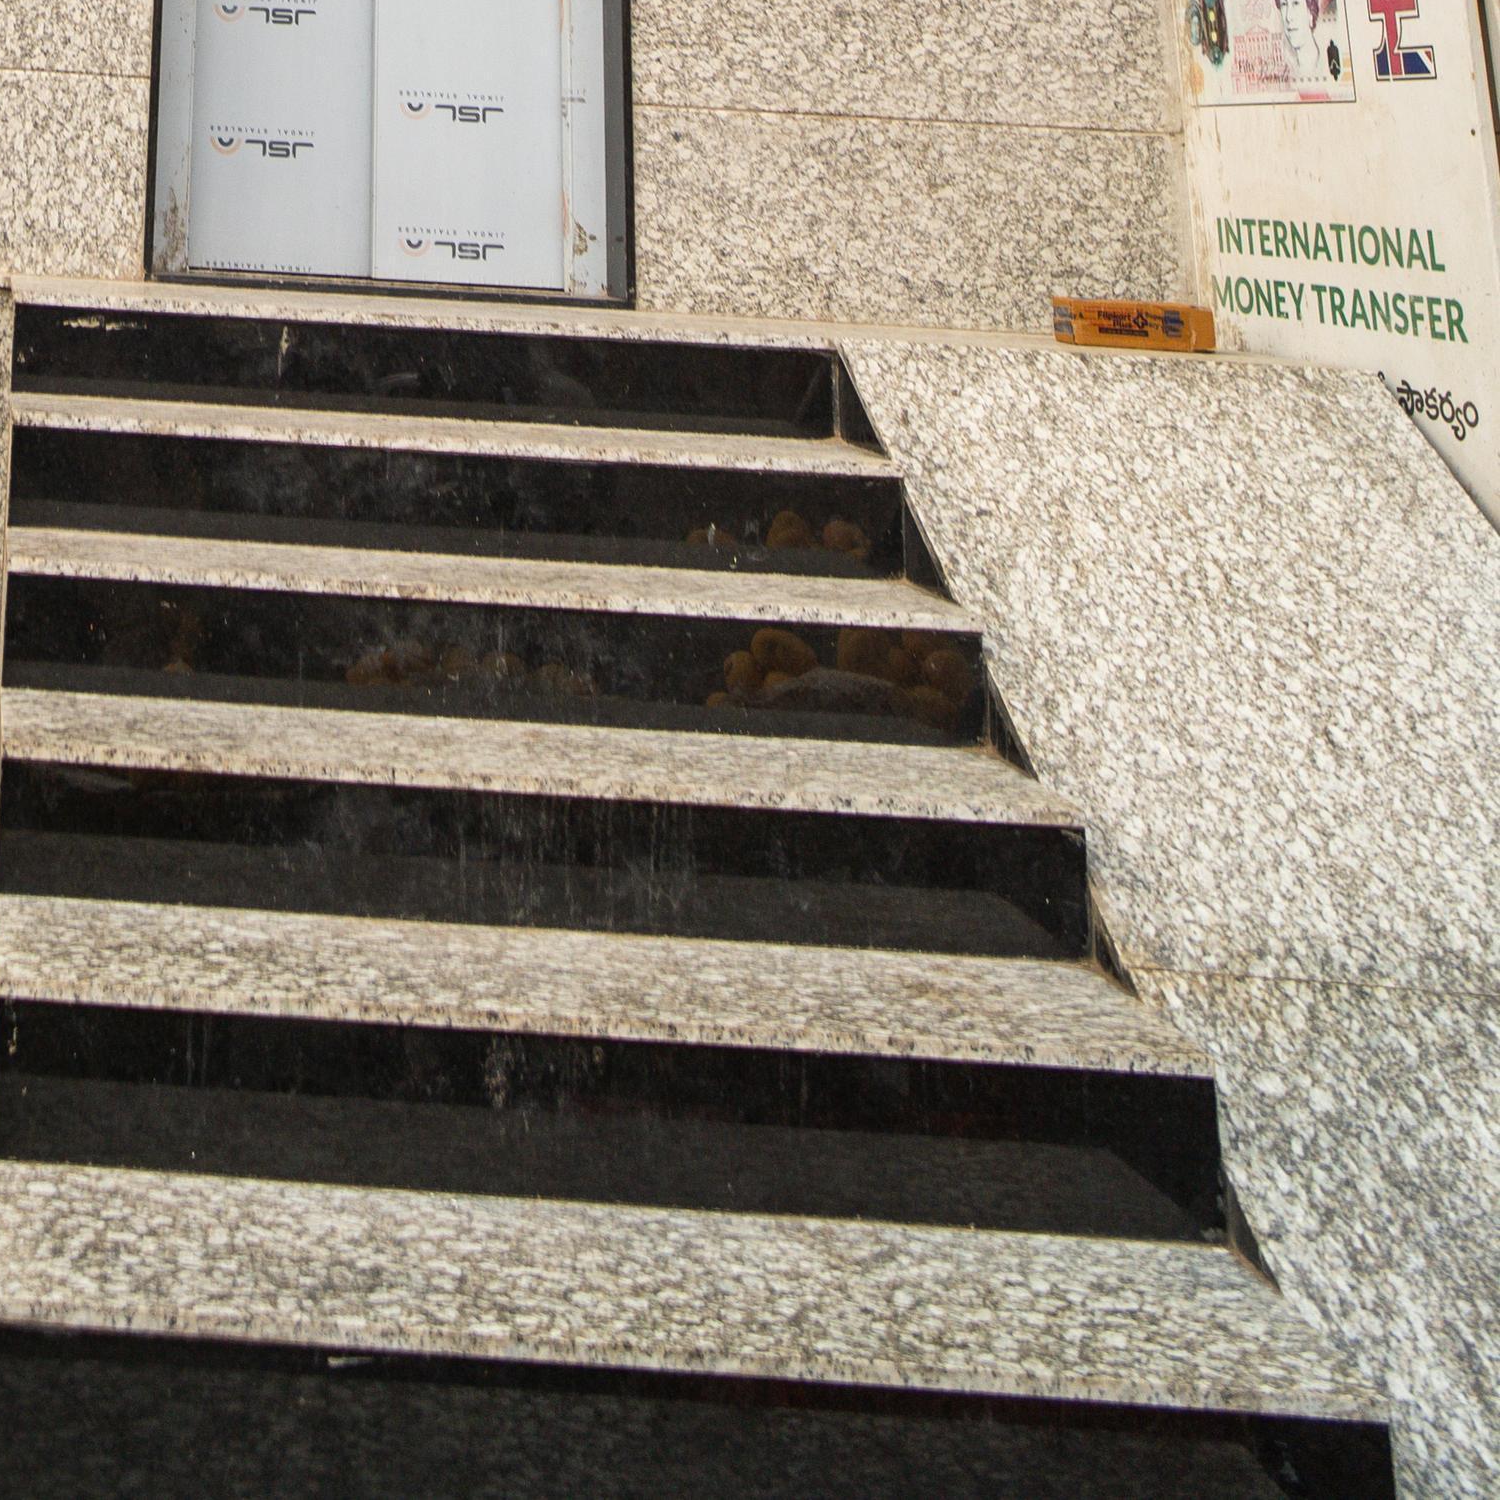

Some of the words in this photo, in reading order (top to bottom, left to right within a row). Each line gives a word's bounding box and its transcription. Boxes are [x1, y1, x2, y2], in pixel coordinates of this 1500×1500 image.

[248, 6, 317, 25] JSL
[435, 104, 505, 124] JSL
[245, 139, 315, 158] JSL
[435, 241, 505, 261] JSL
[1216, 216, 1446, 272] INTERNATIONAL
[1211, 275, 1307, 322] MONEY
[1311, 284, 1469, 345] TRANSFER
